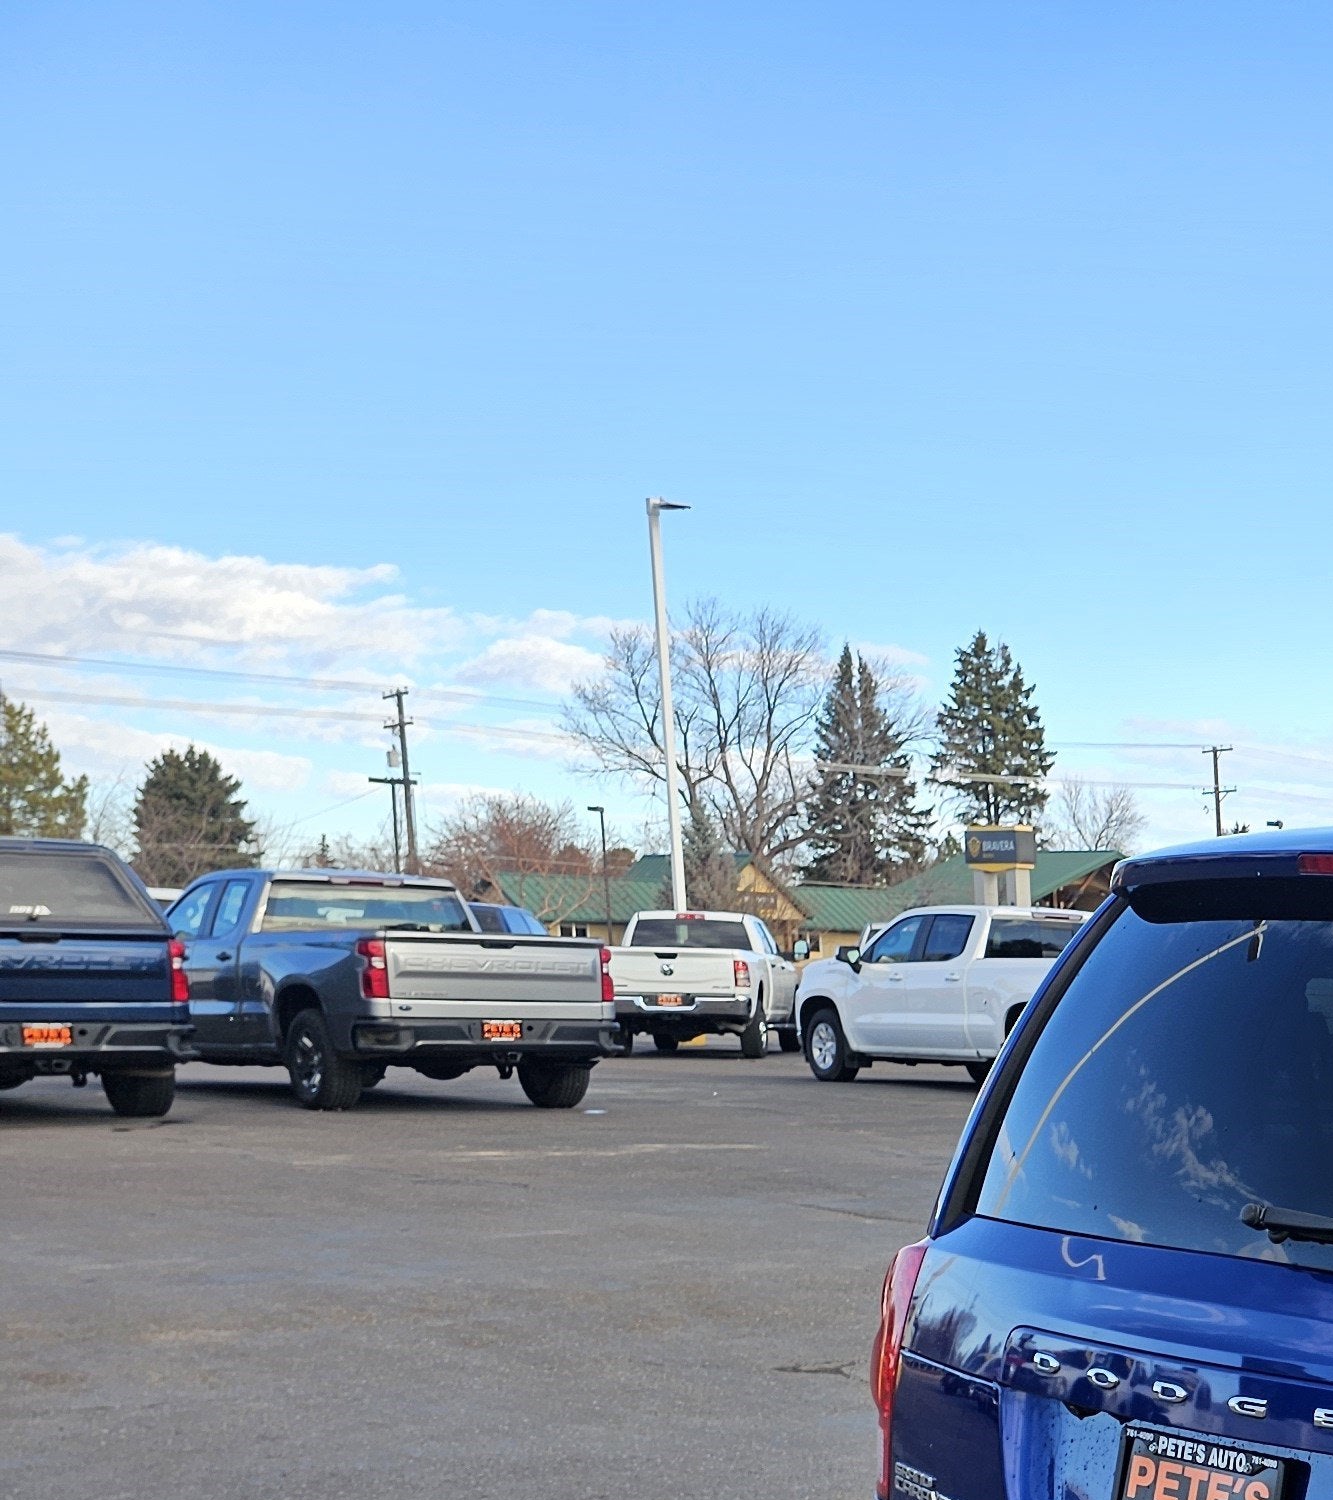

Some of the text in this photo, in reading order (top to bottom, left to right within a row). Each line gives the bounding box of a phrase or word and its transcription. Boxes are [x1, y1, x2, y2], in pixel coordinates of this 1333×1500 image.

[404, 957, 588, 977] CHEVROLET
[1158, 1436, 1245, 1473] PETE'S AUTO
